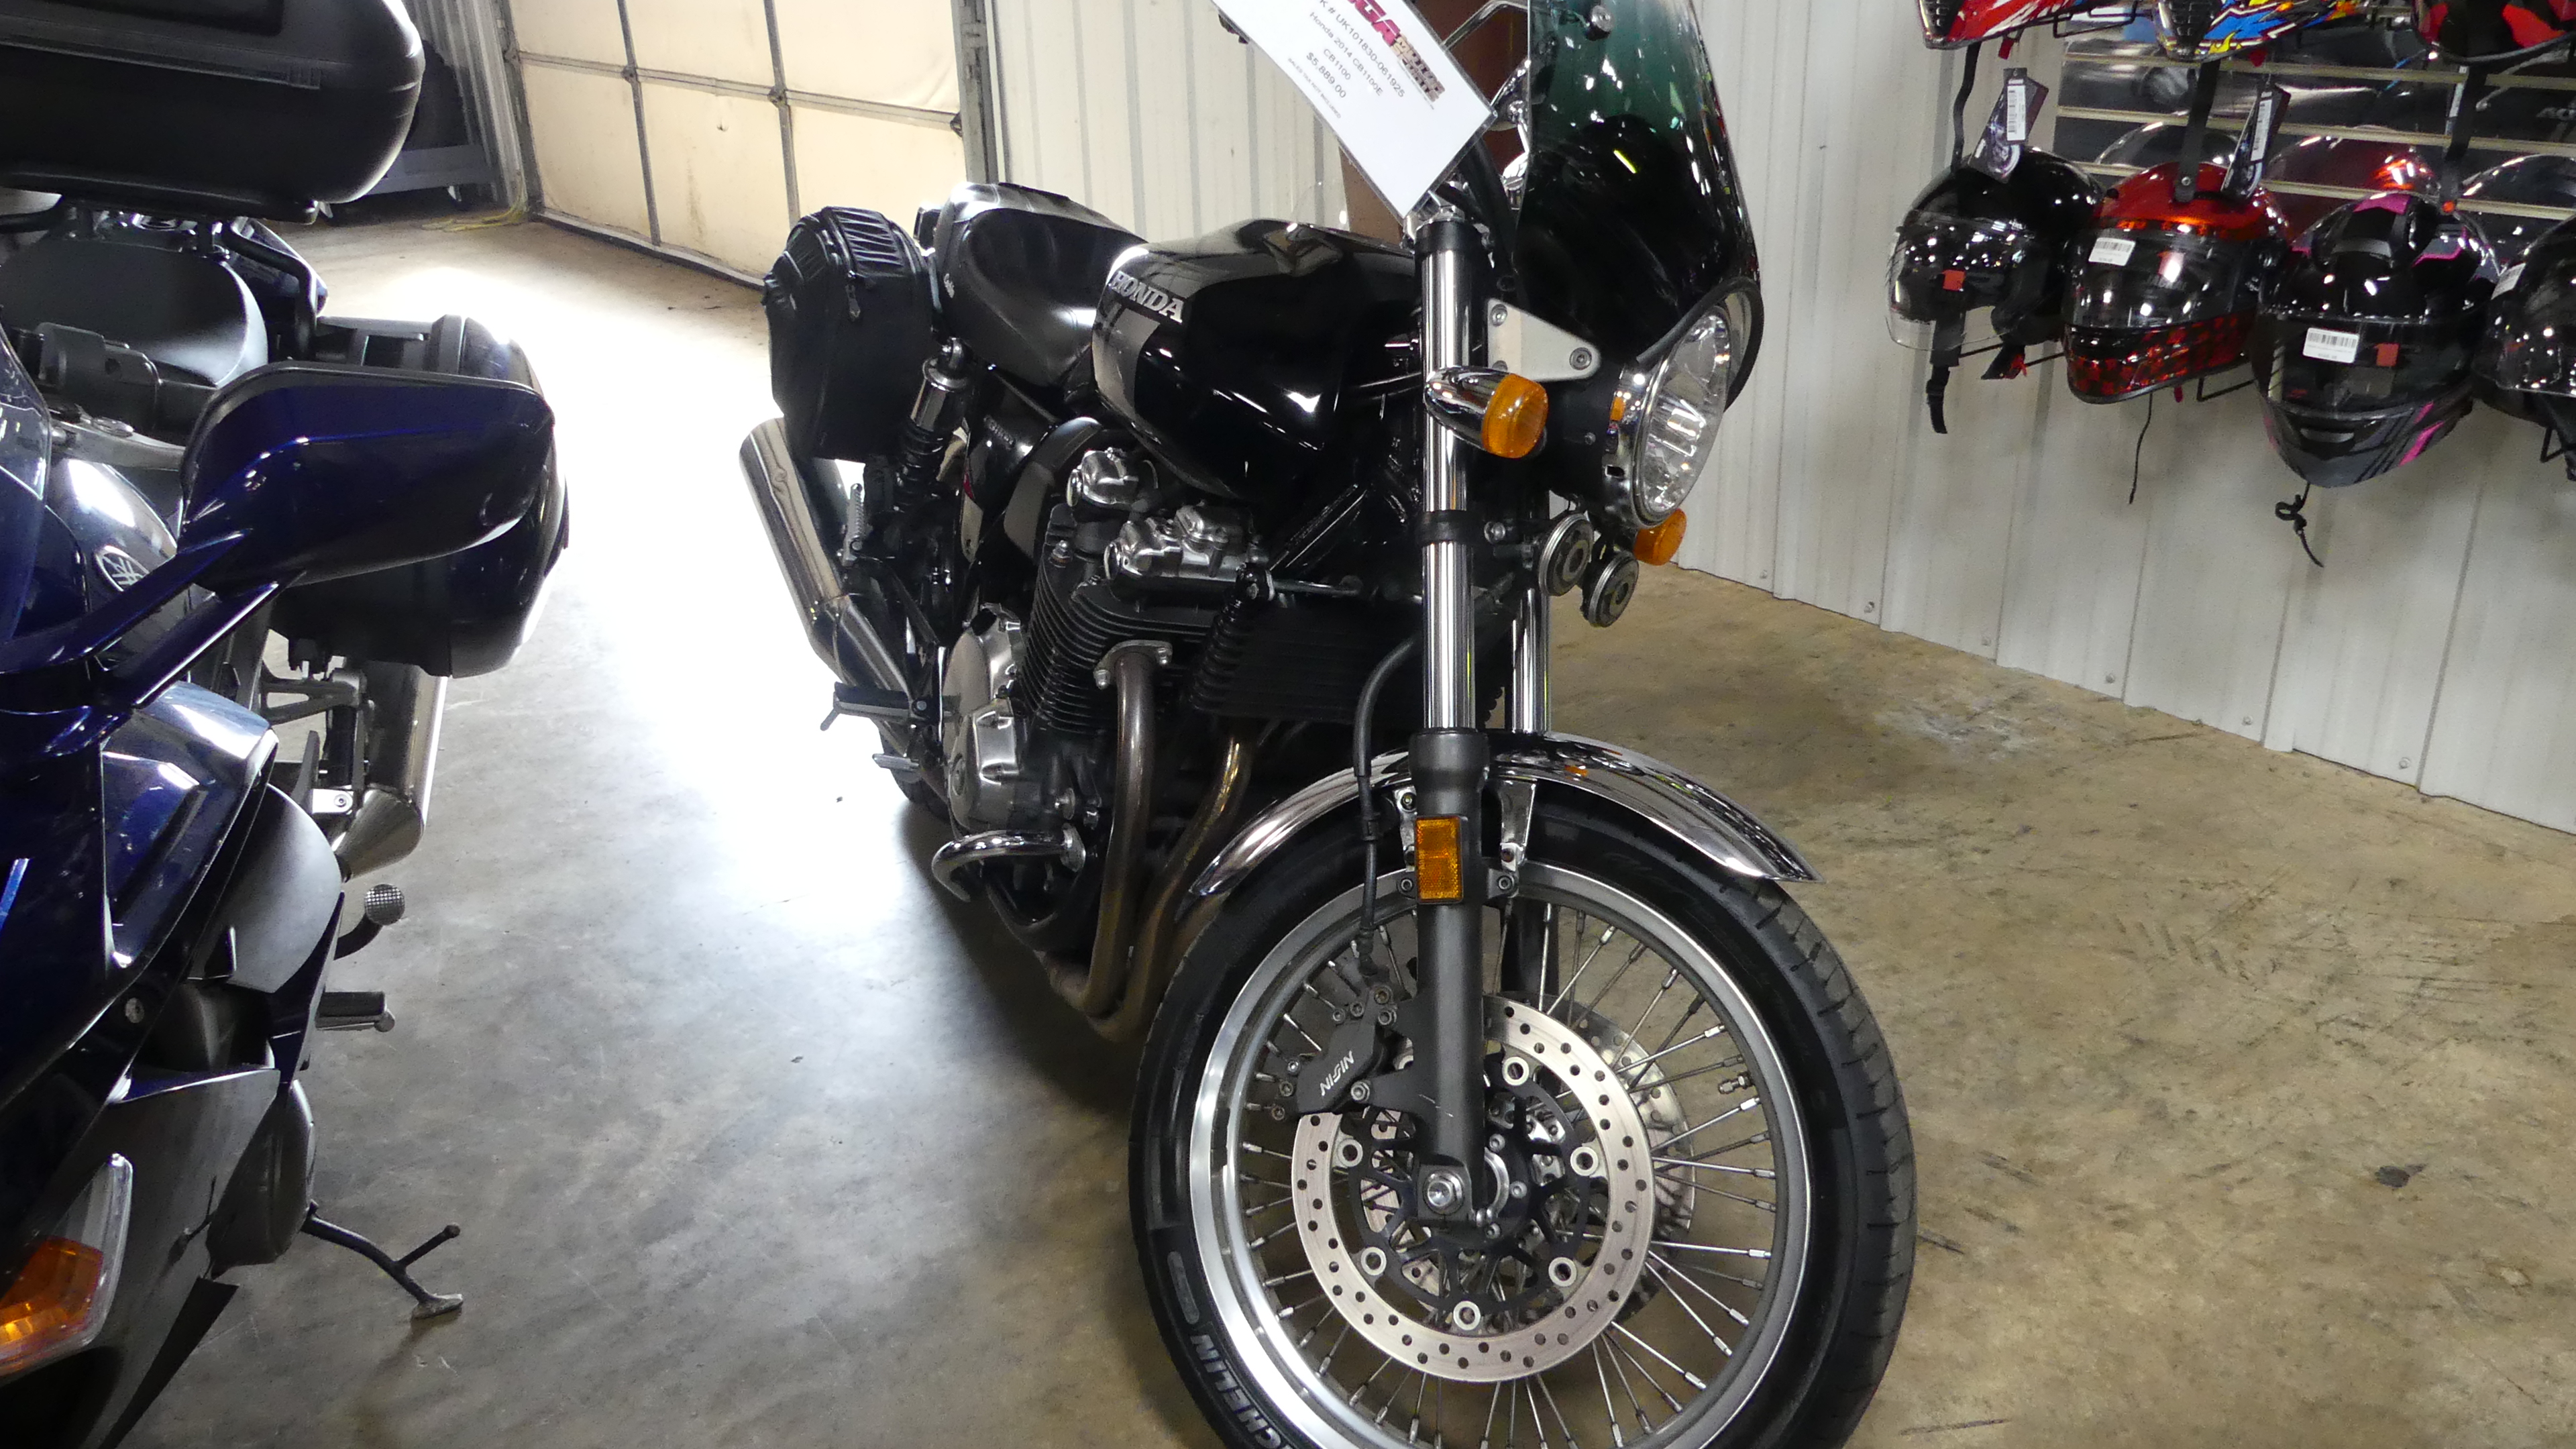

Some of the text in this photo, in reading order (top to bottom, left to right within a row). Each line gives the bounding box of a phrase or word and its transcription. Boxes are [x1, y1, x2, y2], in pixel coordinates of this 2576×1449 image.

[1347, 0, 1401, 47] GA
[1306, 52, 1346, 98] $5,889.00
[1309, 12, 1383, 96] Honda 2014 CB1100E
[1324, 48, 1351, 80] CB1100
[1336, 14, 1405, 97] UK101830-061925
[1287, 58, 1303, 73] SALES
[1311, 83, 1322, 94] NOT
[1320, 93, 1341, 119] INCLUDED
[1109, 270, 1185, 324] HONDA
[1190, 1334, 1293, 1449] CHELIN
